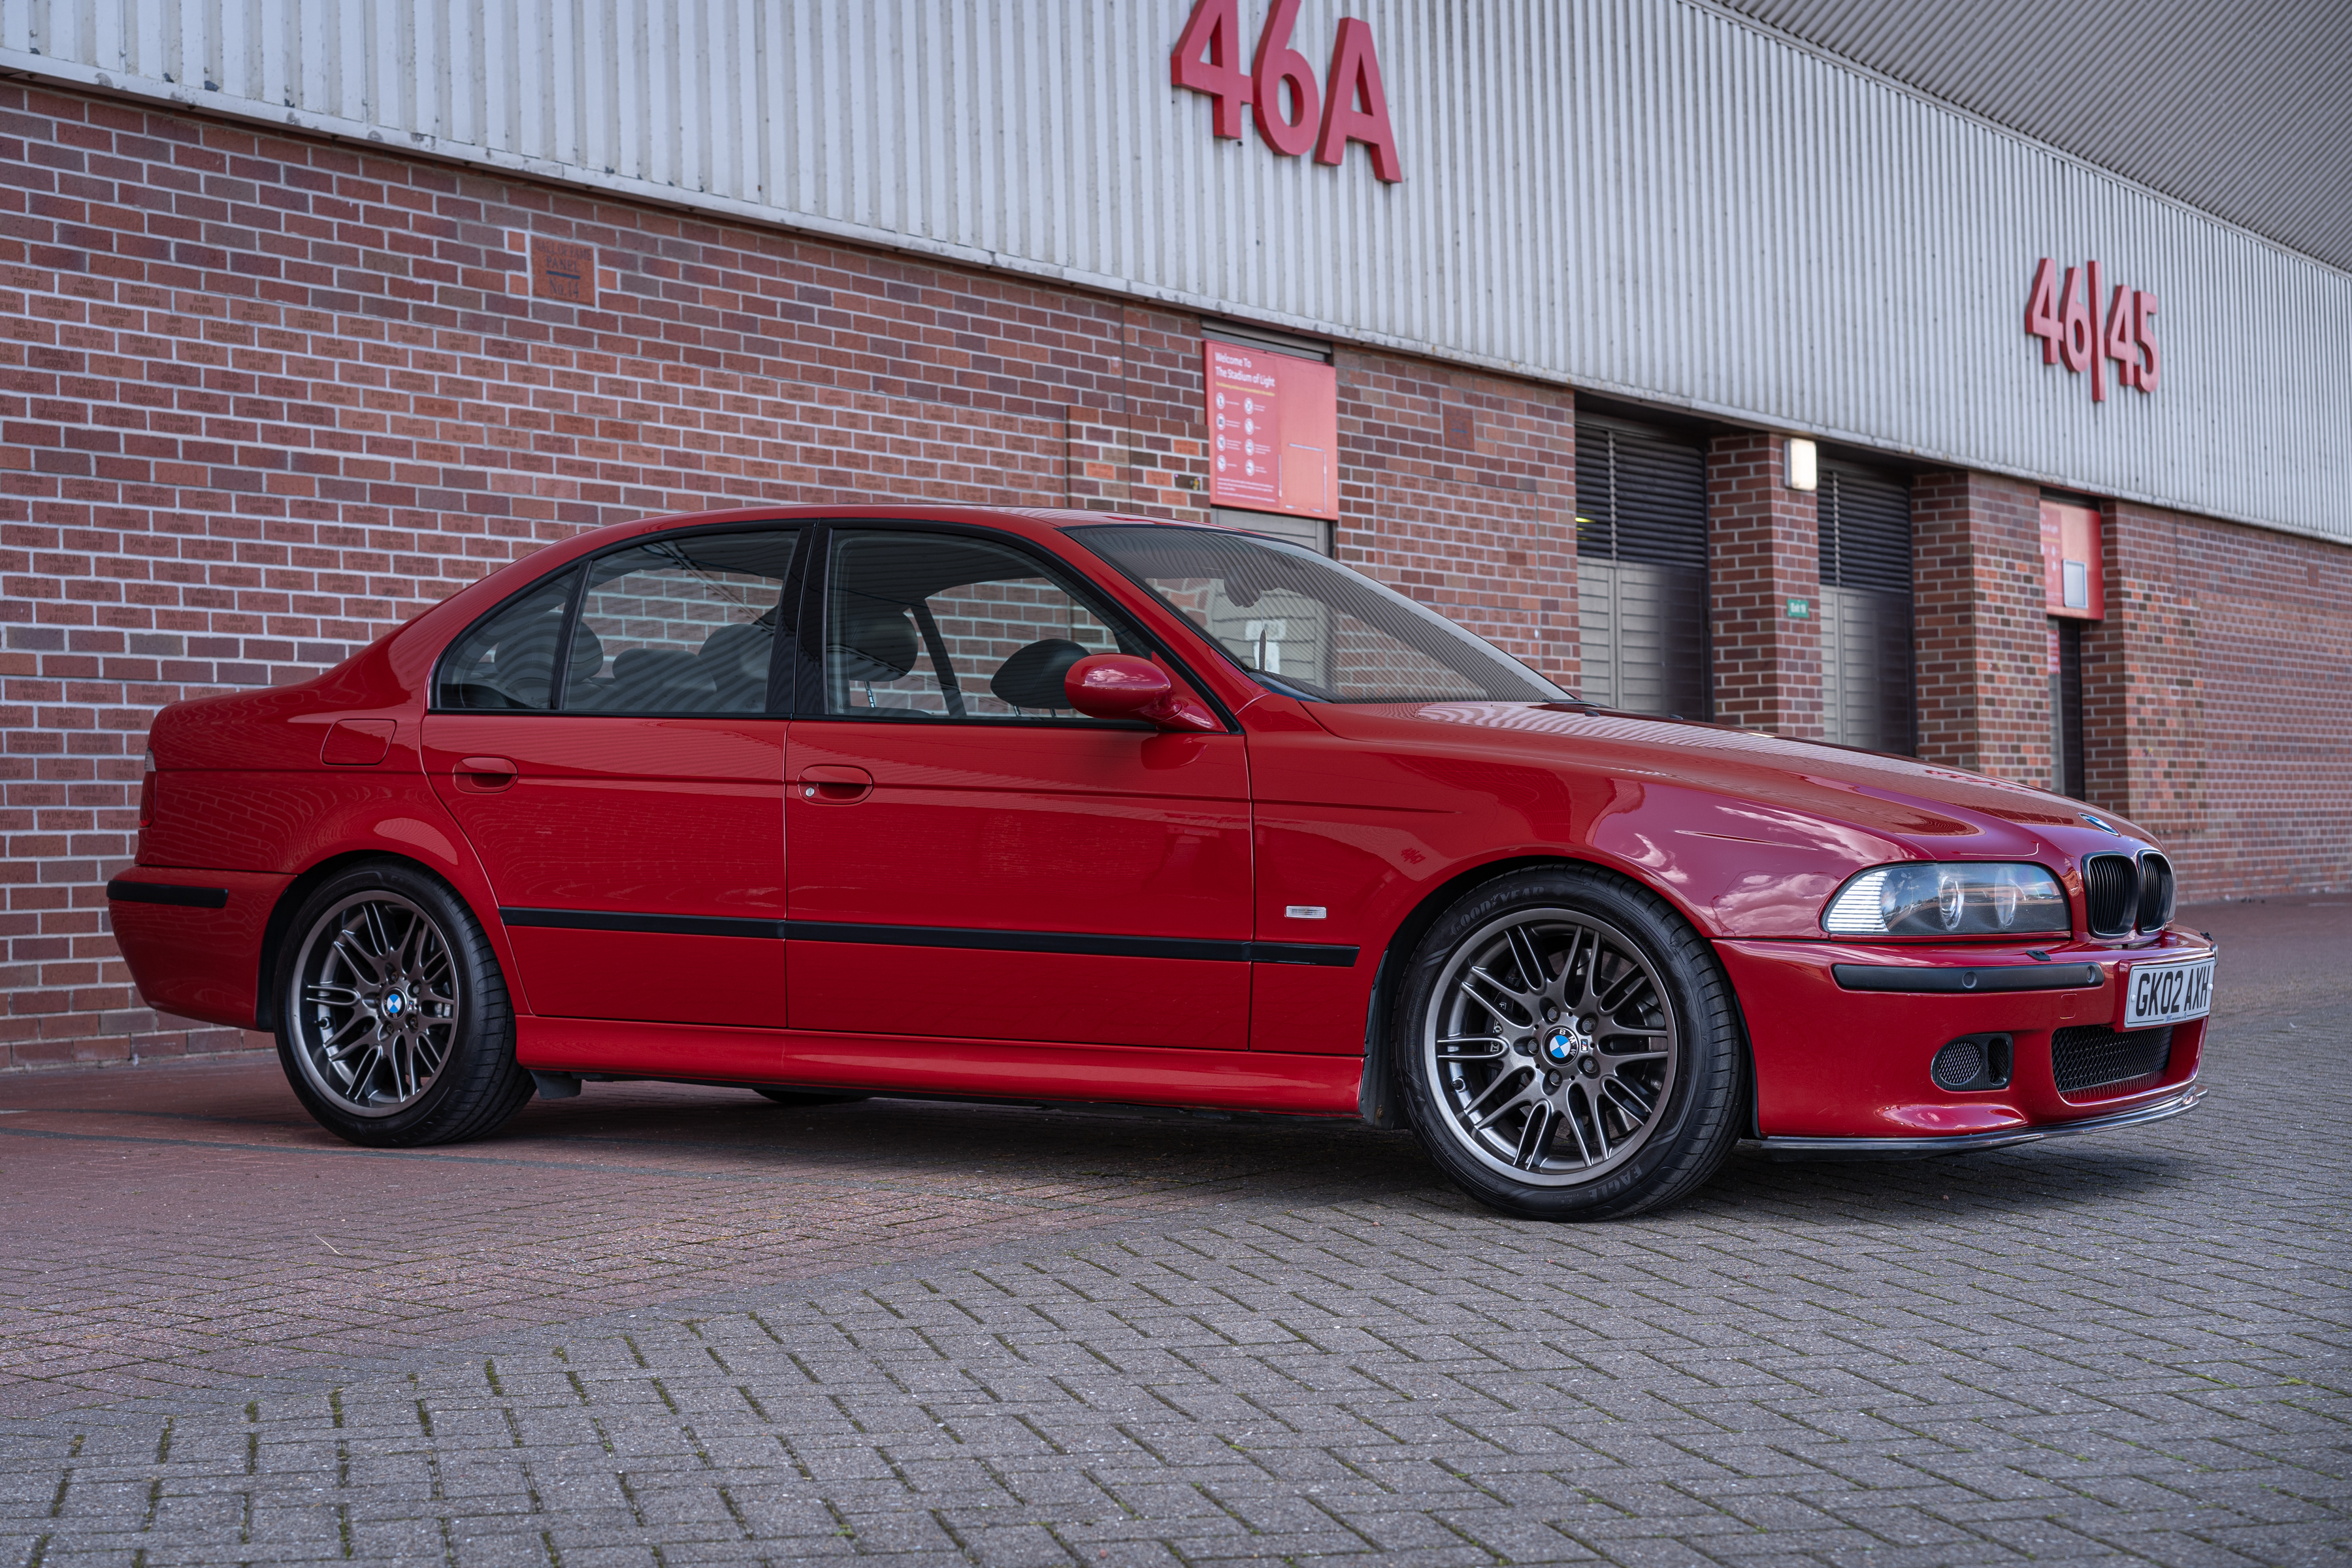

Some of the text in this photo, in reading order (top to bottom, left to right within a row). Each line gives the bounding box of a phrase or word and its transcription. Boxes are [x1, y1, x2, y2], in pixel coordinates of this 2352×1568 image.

[1171, 0, 1403, 184] 46A
[546, 255, 580, 273] PANEL
[1215, 351, 1252, 368] Welcome To
[1215, 365, 1276, 389] The Stadium of Light
[2136, 965, 2211, 1017] GK02 AXH
[1588, 1163, 1644, 1203] EAGLE
